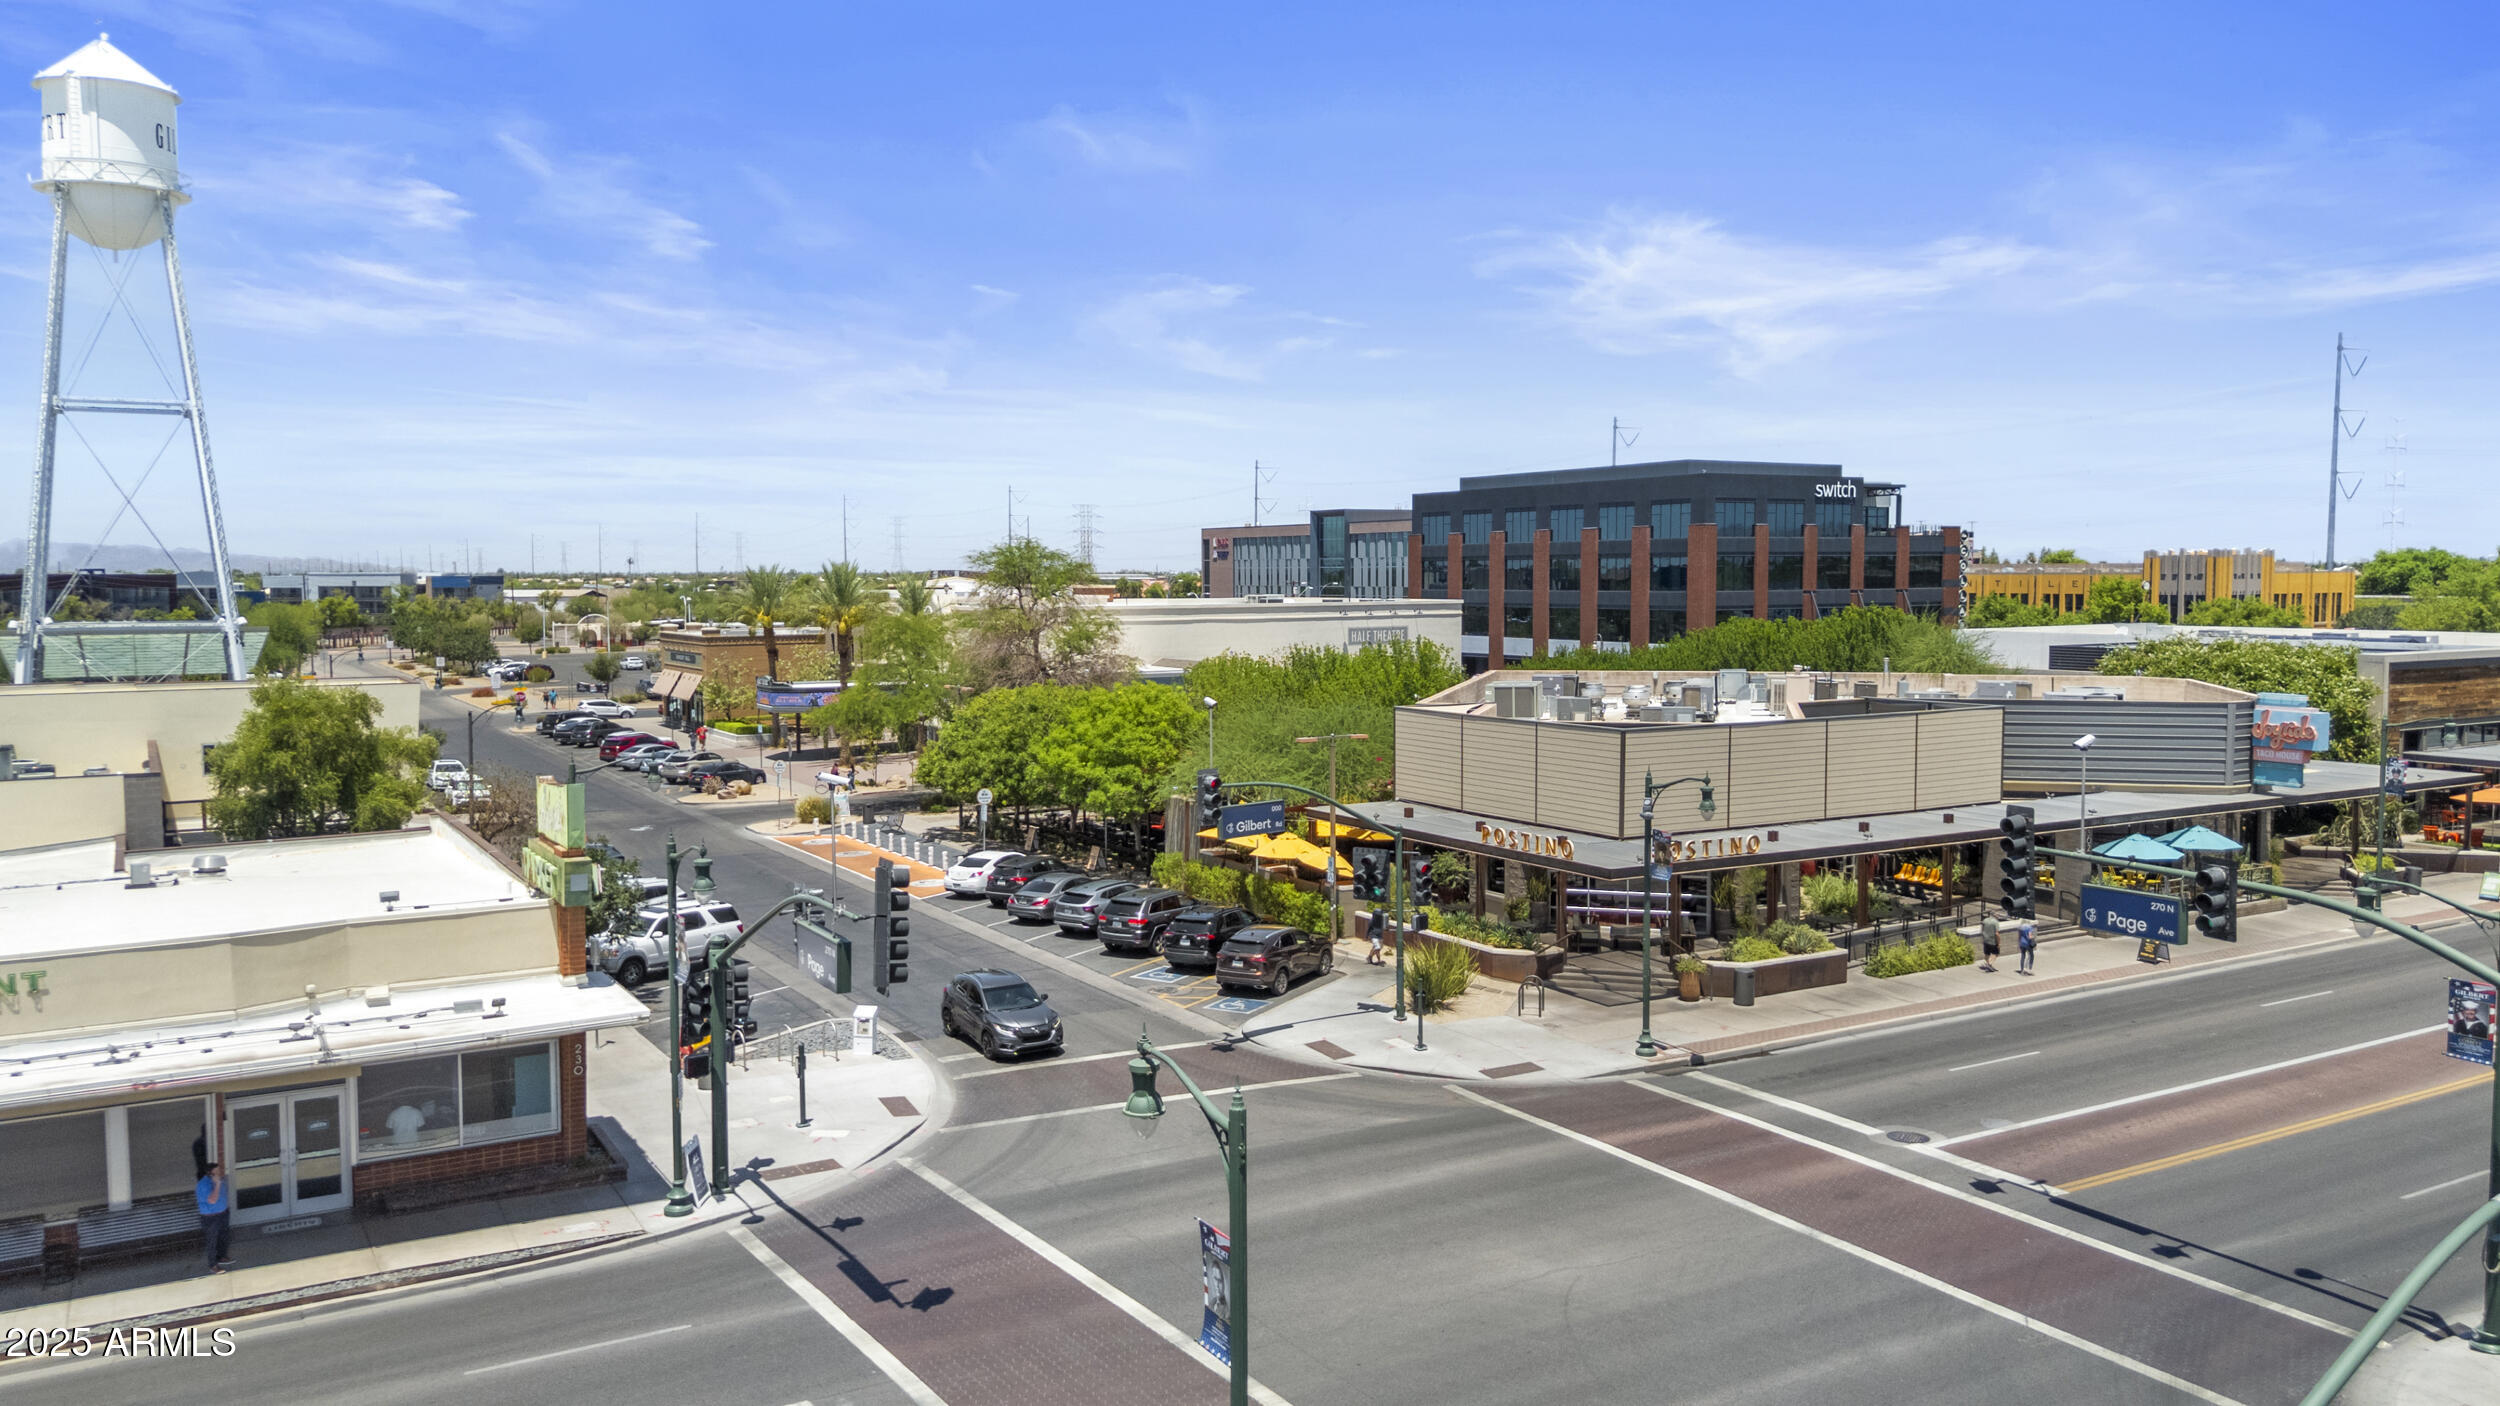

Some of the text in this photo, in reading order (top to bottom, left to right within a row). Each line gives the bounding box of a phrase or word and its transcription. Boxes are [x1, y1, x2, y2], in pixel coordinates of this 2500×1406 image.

[42, 112, 66, 141] RT
[1814, 479, 1857, 498] switch
[1351, 630, 1371, 643] HALE
[2252, 709, 2318, 751] Joyride
[2255, 749, 2301, 761] TACO HOUSE
[1236, 819, 1272, 832] Gilbert
[1481, 824, 1574, 860] POSTINO
[1670, 834, 1760, 862] OSTINO
[2150, 902, 2175, 913] 270 N
[2107, 911, 2147, 934] Page
[2157, 927, 2175, 937] Ave
[807, 953, 824, 979] Page
[2454, 988, 2489, 1000] GILBERT
[573, 1043, 584, 1076] 230
